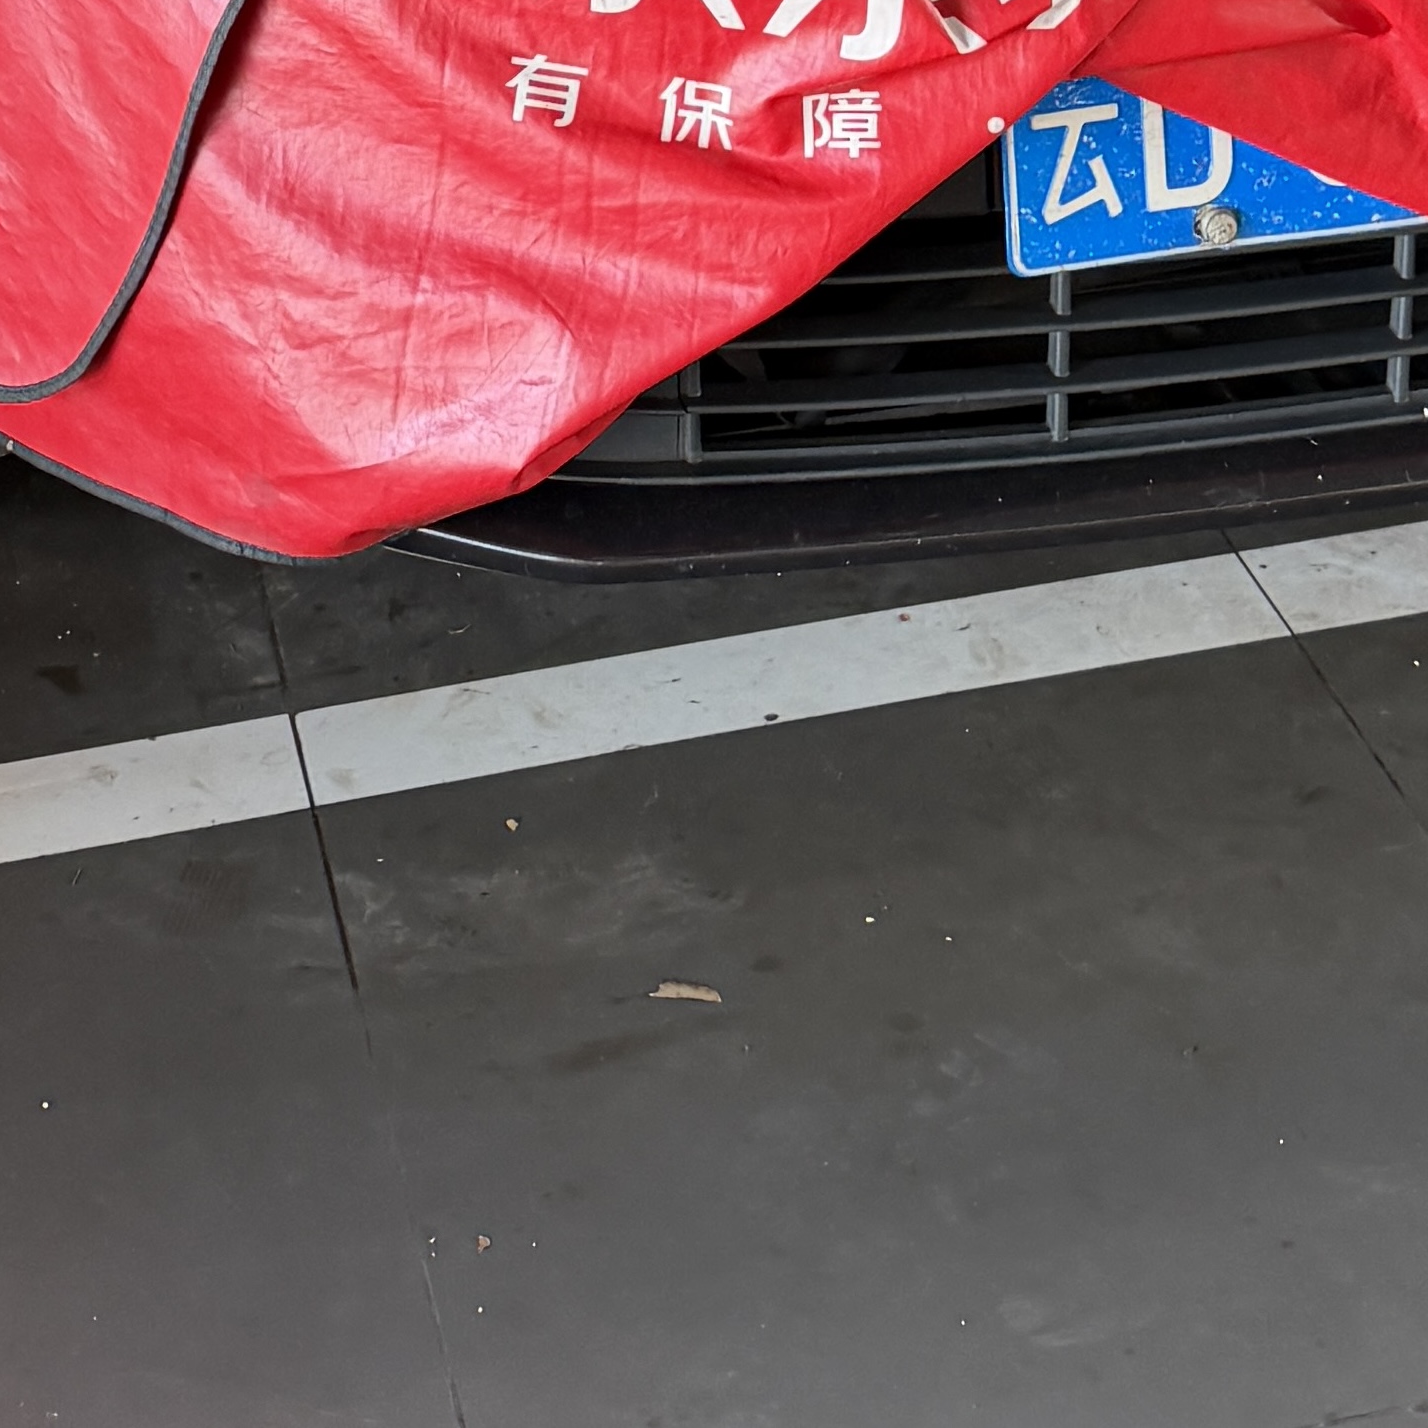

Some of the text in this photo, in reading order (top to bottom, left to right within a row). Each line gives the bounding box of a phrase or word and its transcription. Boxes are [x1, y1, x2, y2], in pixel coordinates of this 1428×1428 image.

[506, 53, 882, 159] 有保障
[1030, 96, 1347, 225] 云D
